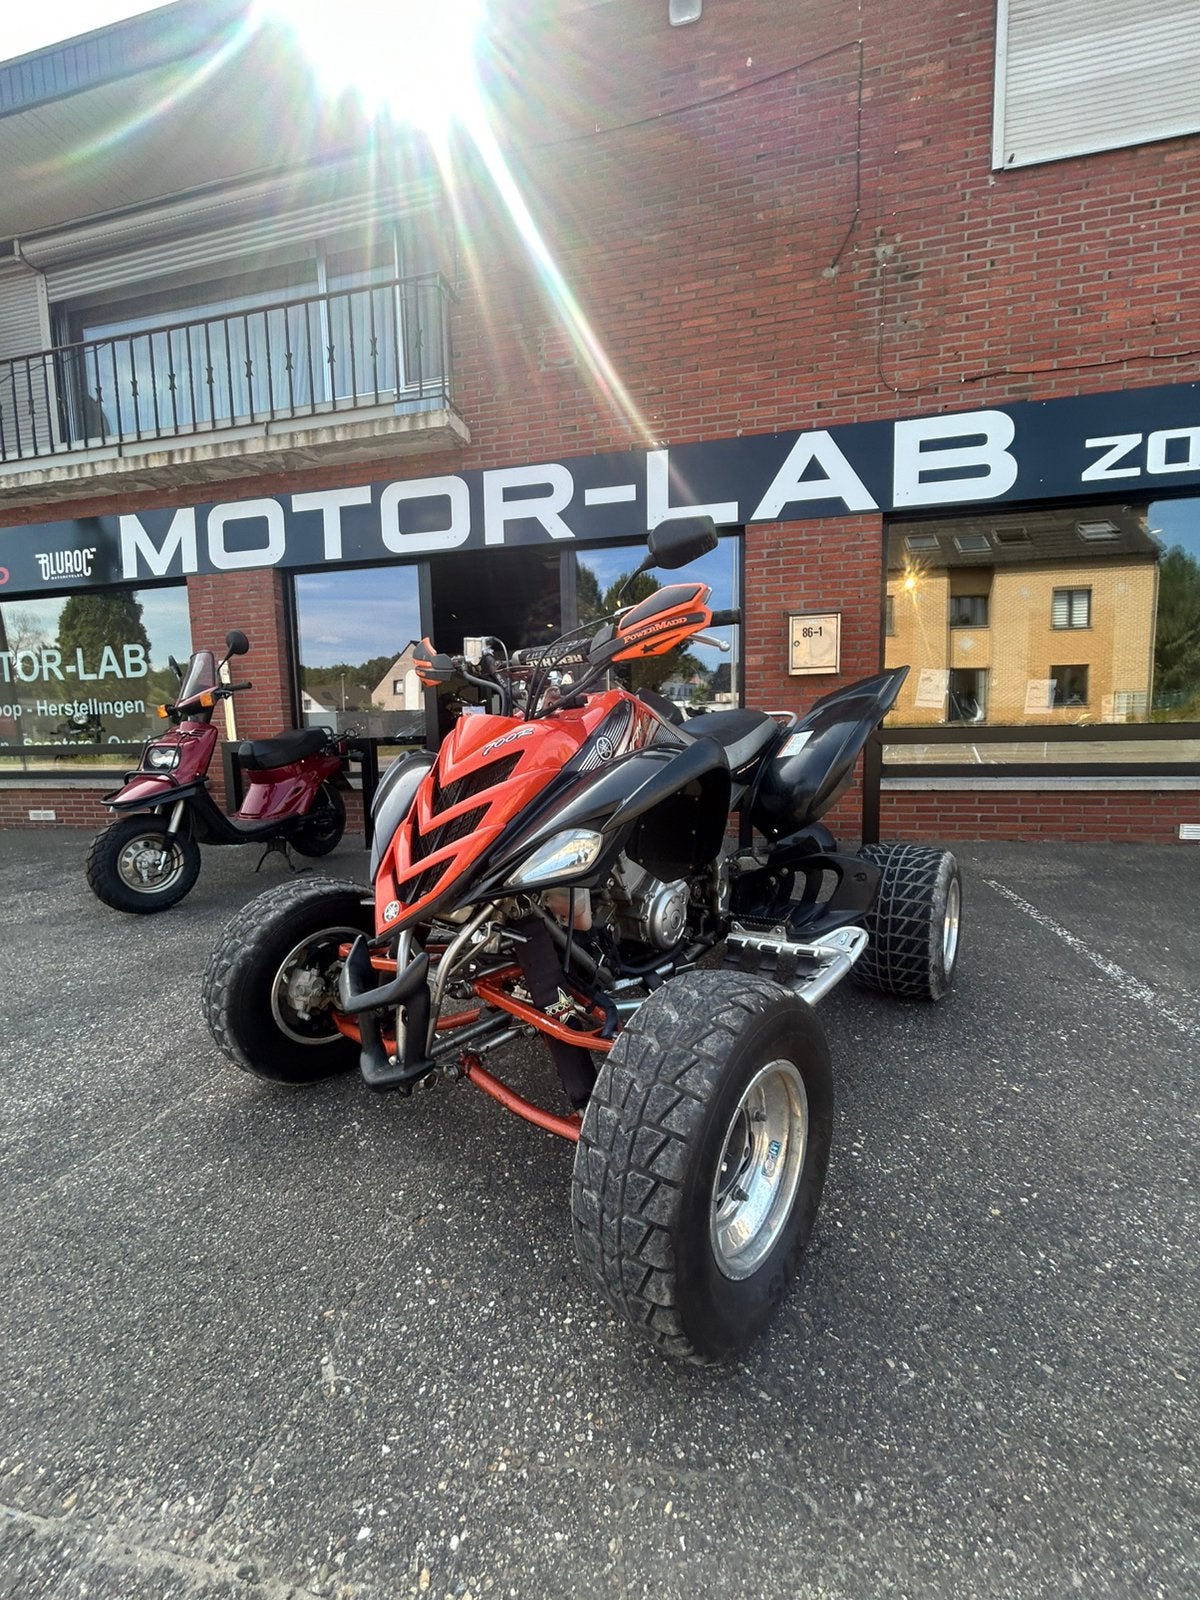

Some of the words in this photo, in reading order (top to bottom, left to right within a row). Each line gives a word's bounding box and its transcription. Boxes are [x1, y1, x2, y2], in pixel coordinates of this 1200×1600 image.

[119, 410, 1018, 579] MOTOR-LAB
[35, 547, 97, 580] BLUROC
[802, 626, 823, 638] 86-1
[0, 704, 22, 721] op
[36, 698, 146, 719] Herstellingen
